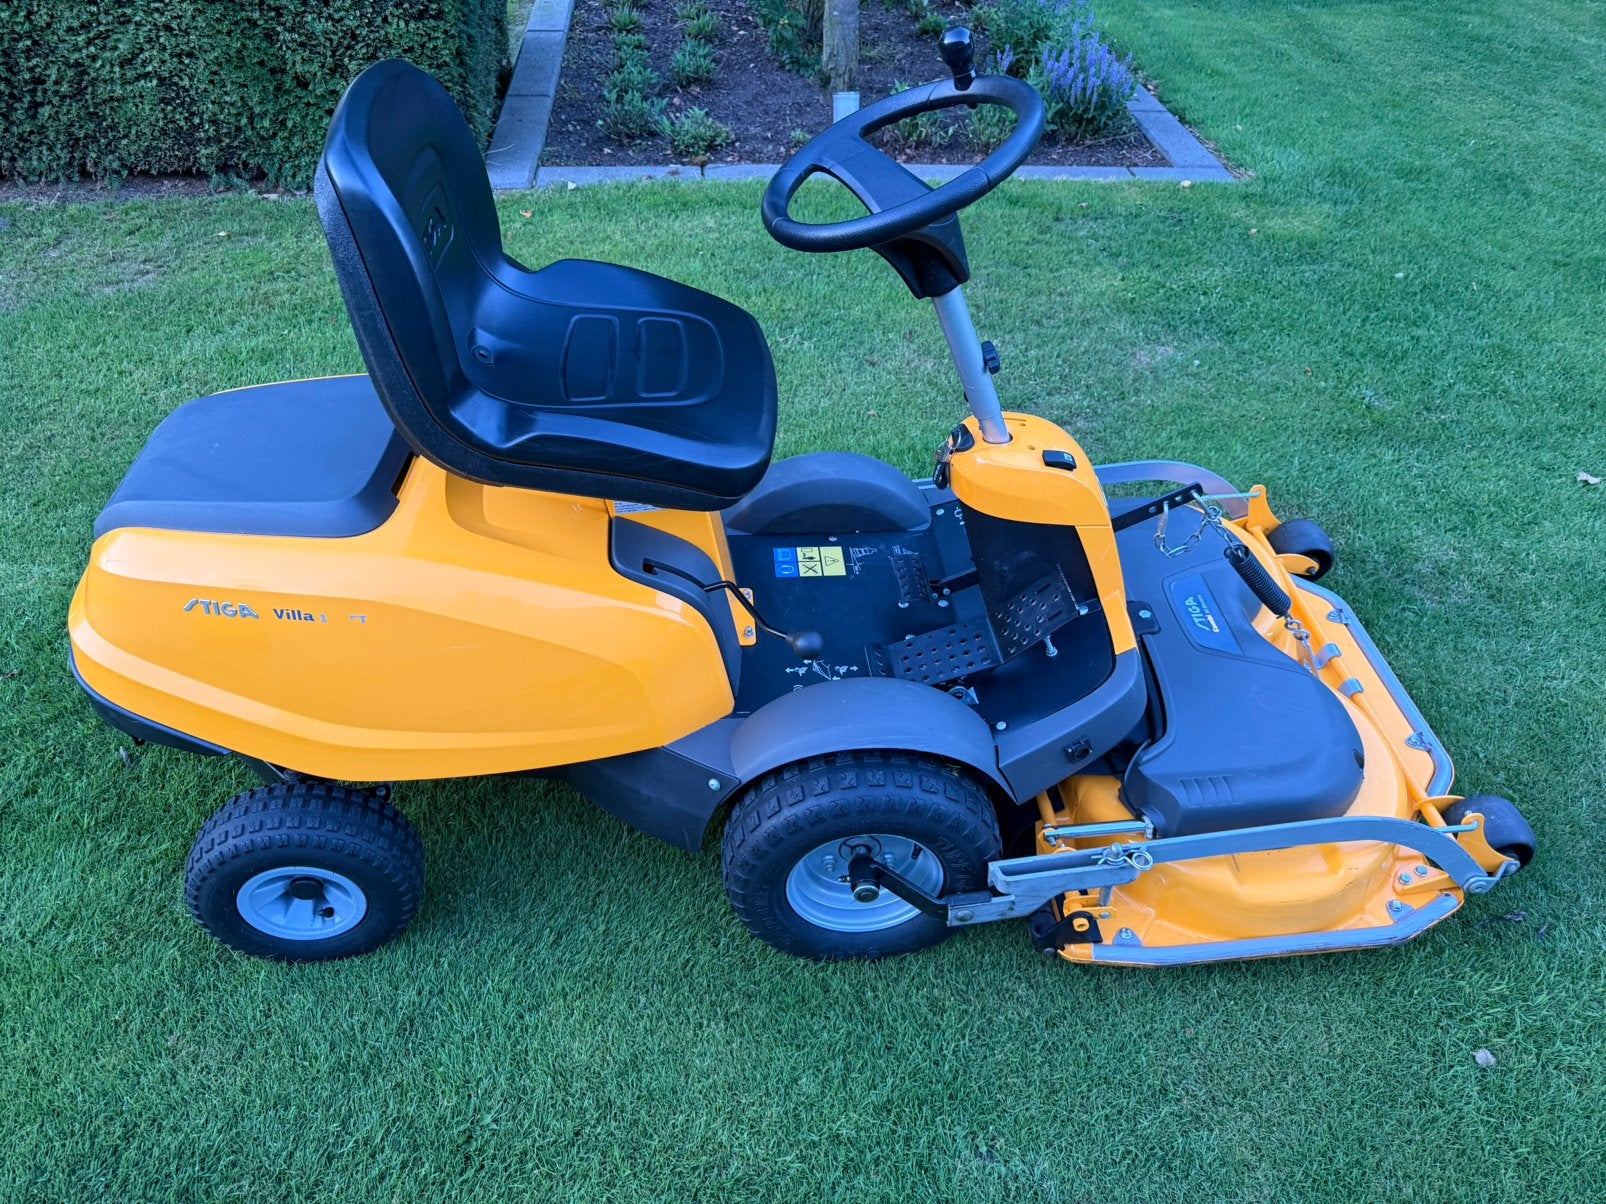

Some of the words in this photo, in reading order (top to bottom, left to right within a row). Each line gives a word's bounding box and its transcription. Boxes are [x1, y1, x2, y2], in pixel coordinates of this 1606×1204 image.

[183, 598, 259, 619] STIGA
[273, 608, 315, 622] Villa
[1184, 596, 1211, 631] STIGA
